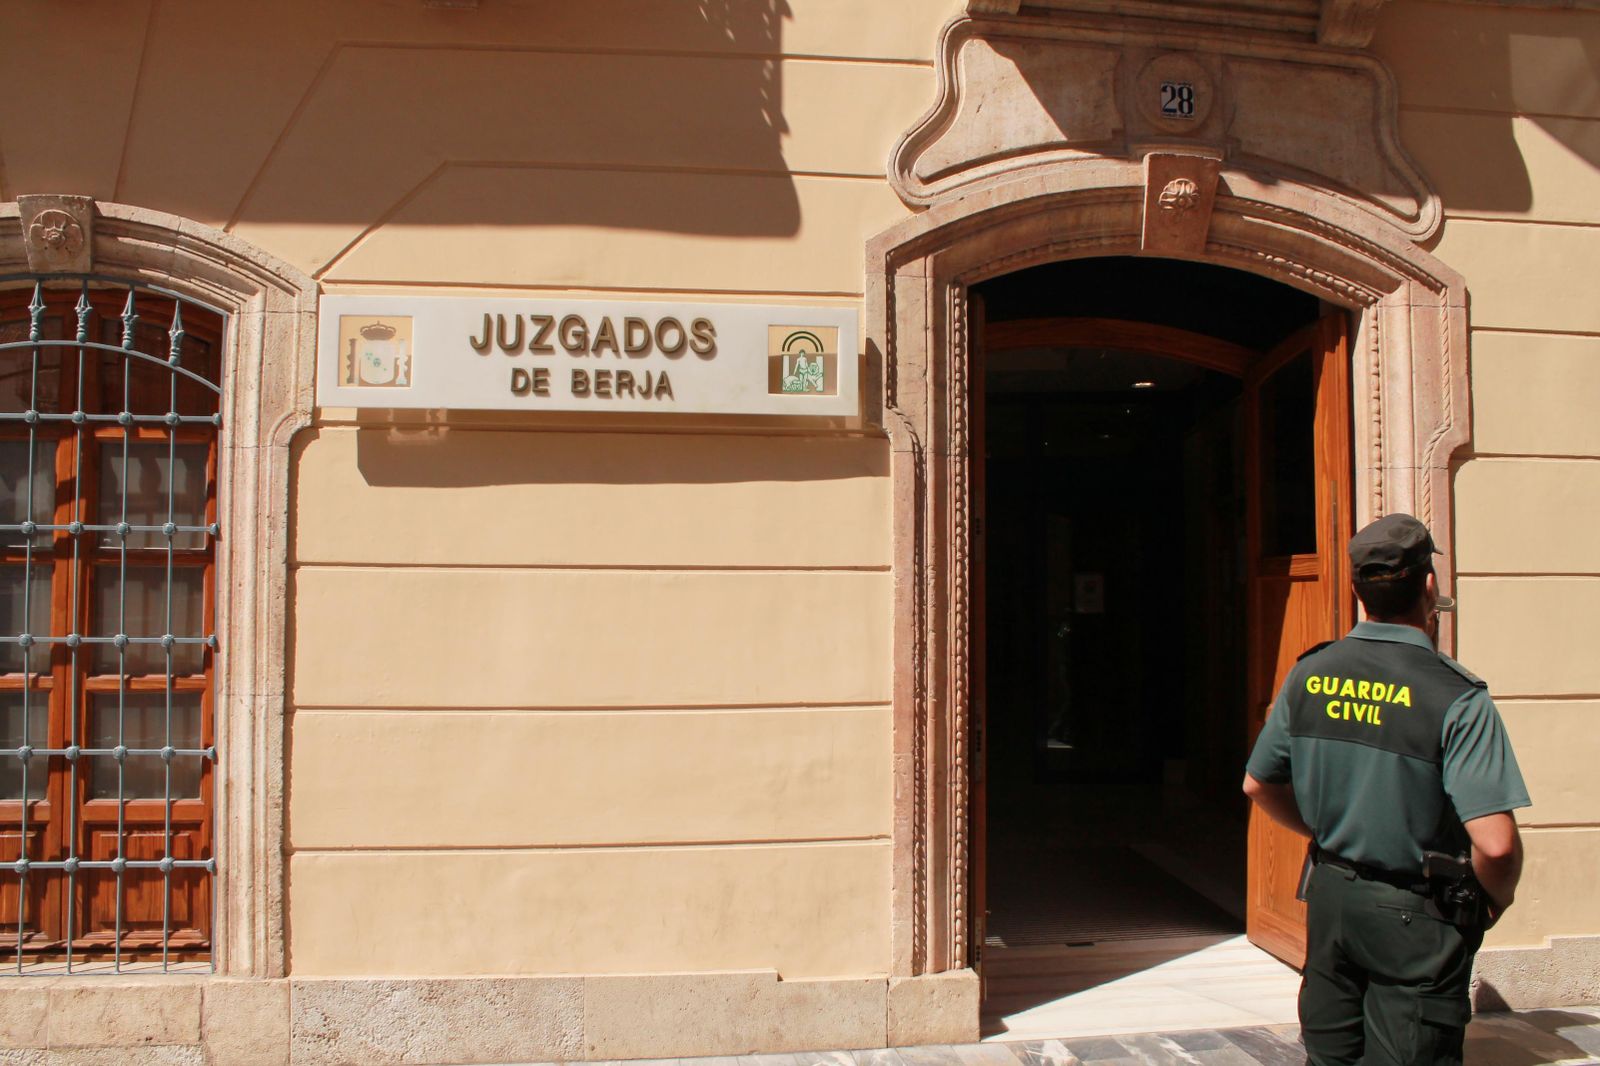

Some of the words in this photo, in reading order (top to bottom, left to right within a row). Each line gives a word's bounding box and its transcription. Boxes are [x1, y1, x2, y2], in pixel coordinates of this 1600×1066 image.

[1161, 85, 1193, 115] 28
[469, 312, 716, 355] JUZGADOS
[510, 367, 549, 395] DE
[571, 368, 673, 399] BERJA
[1305, 676, 1411, 707] GUARDIA
[1326, 700, 1381, 725] CIVIL
